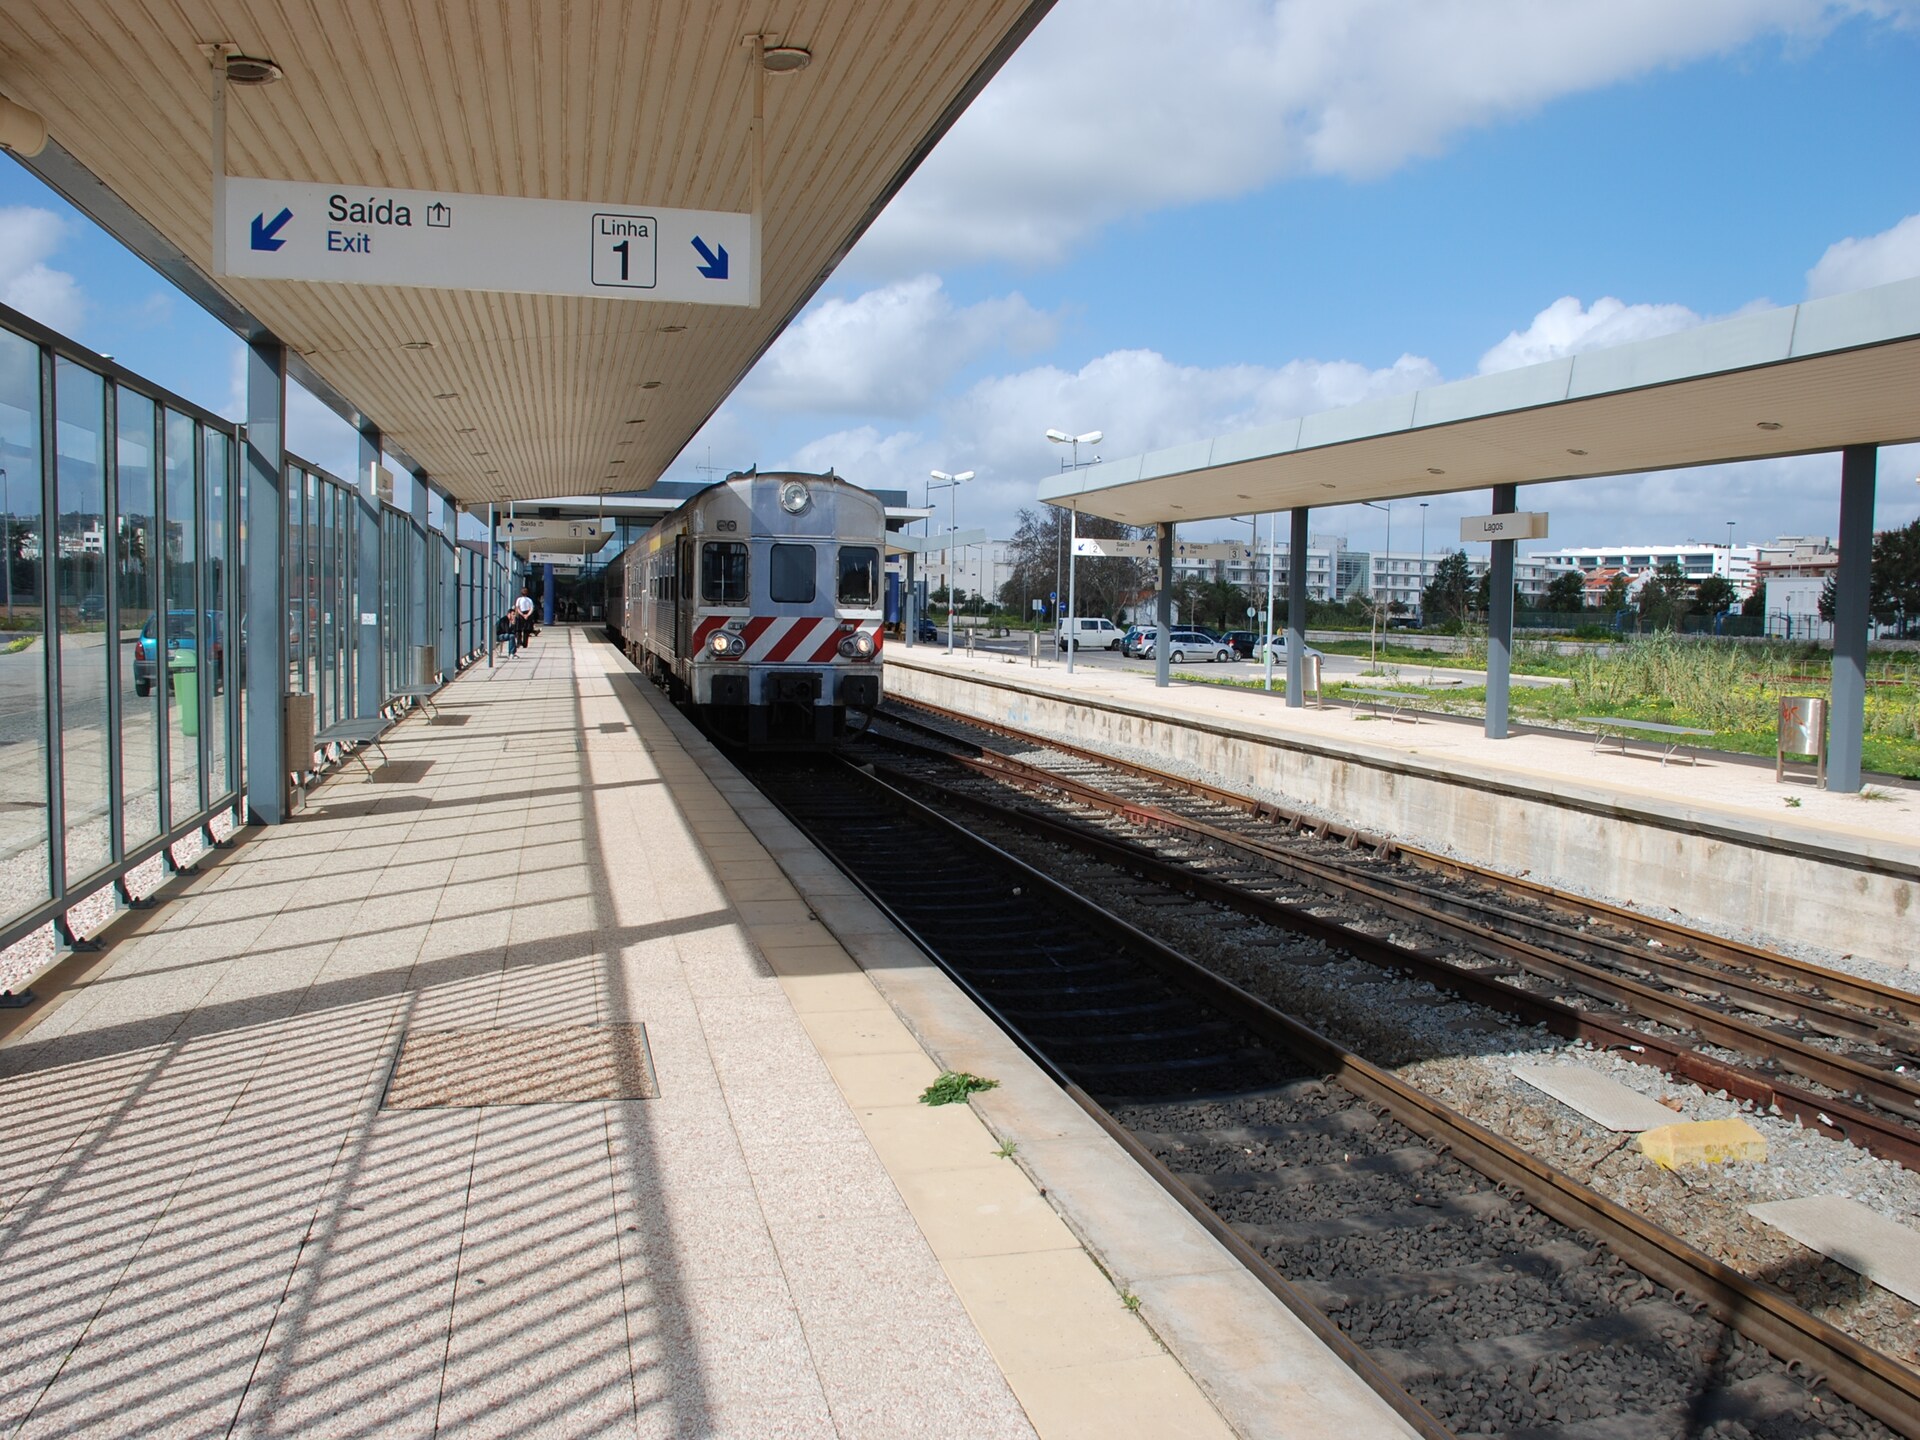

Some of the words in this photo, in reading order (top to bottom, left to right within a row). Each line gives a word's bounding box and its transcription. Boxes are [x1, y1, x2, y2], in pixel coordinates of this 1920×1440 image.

[328, 194, 412, 226] Saída
[601, 218, 648, 237] Linha
[328, 230, 371, 253] Exit
[613, 240, 628, 280] 1
[573, 527, 577, 536] 1
[1483, 521, 1504, 533] Lagos
[1092, 544, 1098, 553] 2
[1231, 550, 1237, 559] 3
